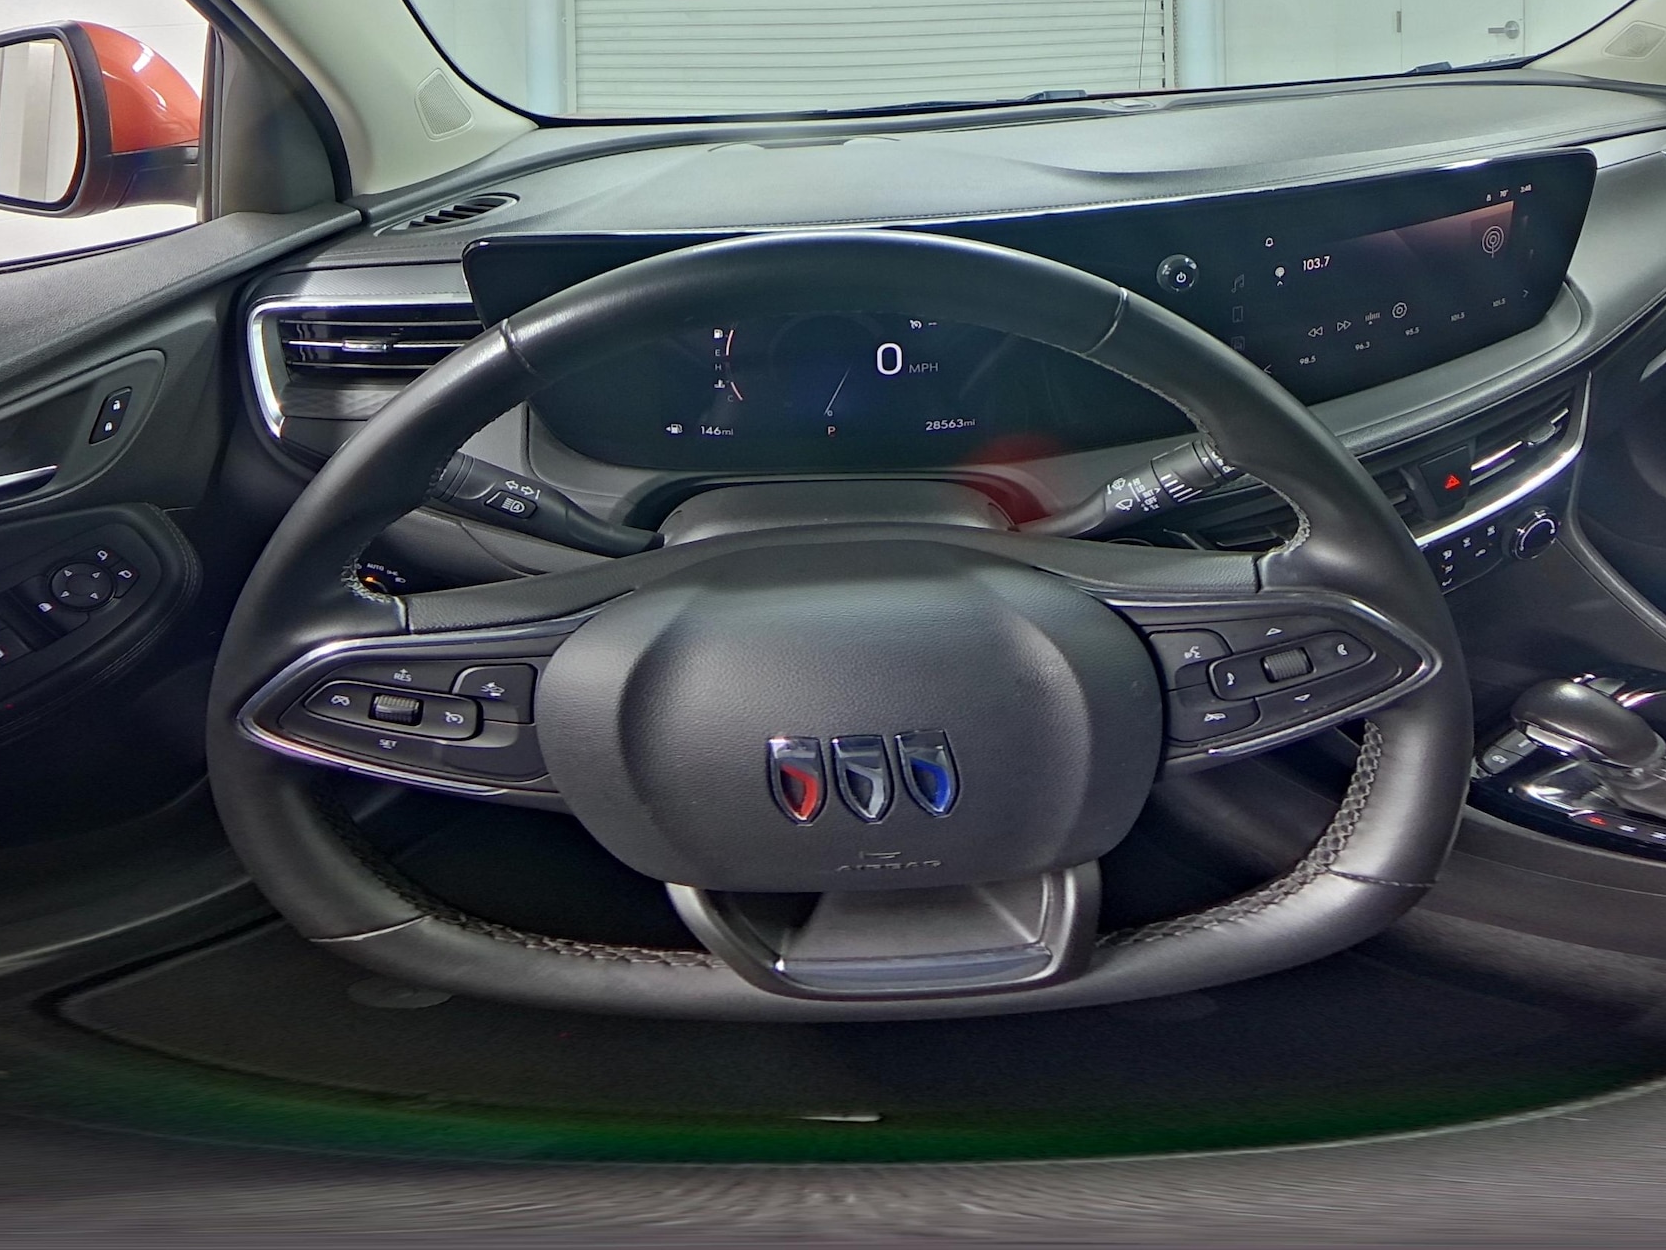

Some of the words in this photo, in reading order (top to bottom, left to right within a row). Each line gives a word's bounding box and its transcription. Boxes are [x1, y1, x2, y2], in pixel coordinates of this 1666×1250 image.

[1302, 255, 1331, 272] 103.7
[876, 342, 903, 375] 0
[908, 362, 939, 374] MPH
[393, 672, 412, 682] RES
[379, 738, 398, 748] SET
